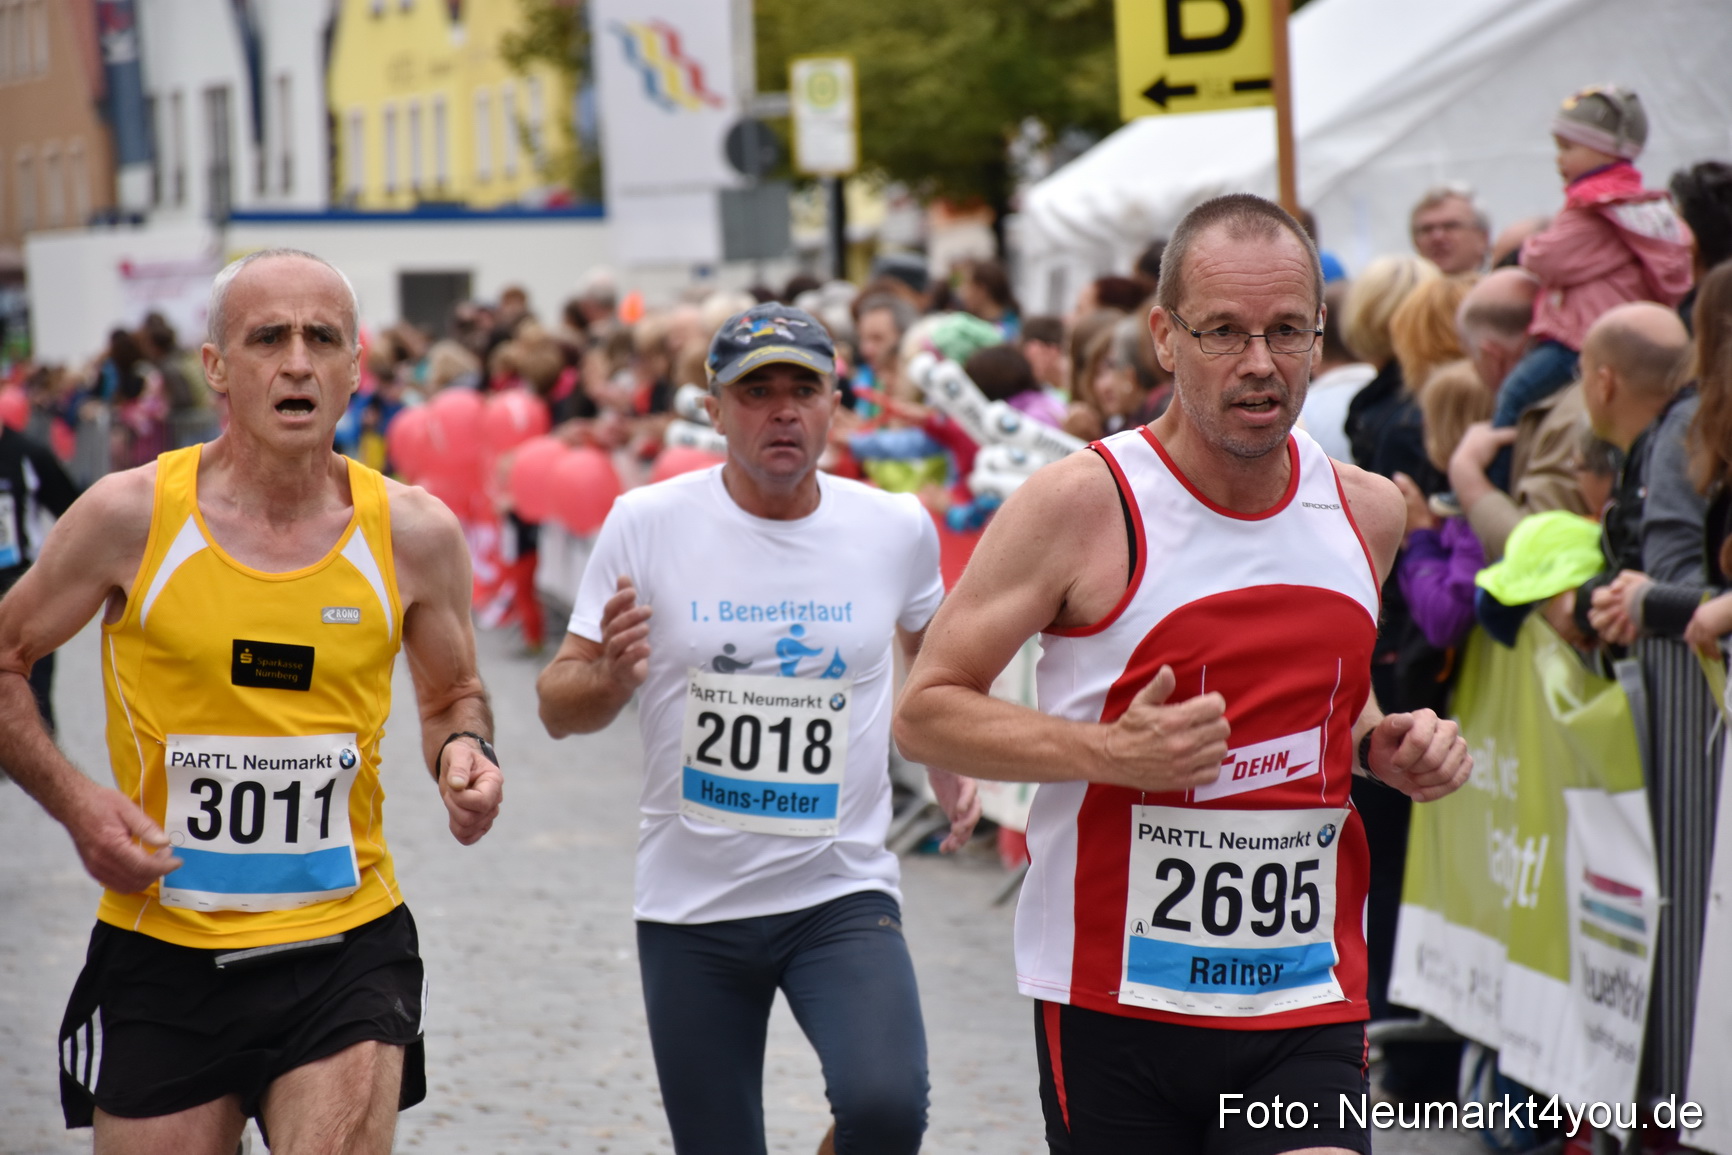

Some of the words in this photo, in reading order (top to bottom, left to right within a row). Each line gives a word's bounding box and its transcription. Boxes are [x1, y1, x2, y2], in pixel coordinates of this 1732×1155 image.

[1302, 501, 1340, 510] BROOKS
[719, 600, 852, 623] Benefizlauf
[257, 656, 303, 670] Sparkasse
[690, 682, 738, 705] PARTL
[743, 691, 822, 709] Neumarkt
[696, 711, 832, 775] 2018
[171, 751, 237, 770] PARTL
[243, 754, 332, 770] Neumarkt
[1232, 749, 1290, 781] DEHN
[701, 779, 820, 813] Hans-Peter
[187, 777, 337, 844] 3011
[1138, 823, 1212, 849] PARTL
[1219, 831, 1311, 850] Neumarkt
[1151, 858, 1320, 937] 2695
[1135, 921, 1144, 934] A
[1190, 956, 1284, 986] Rainer
